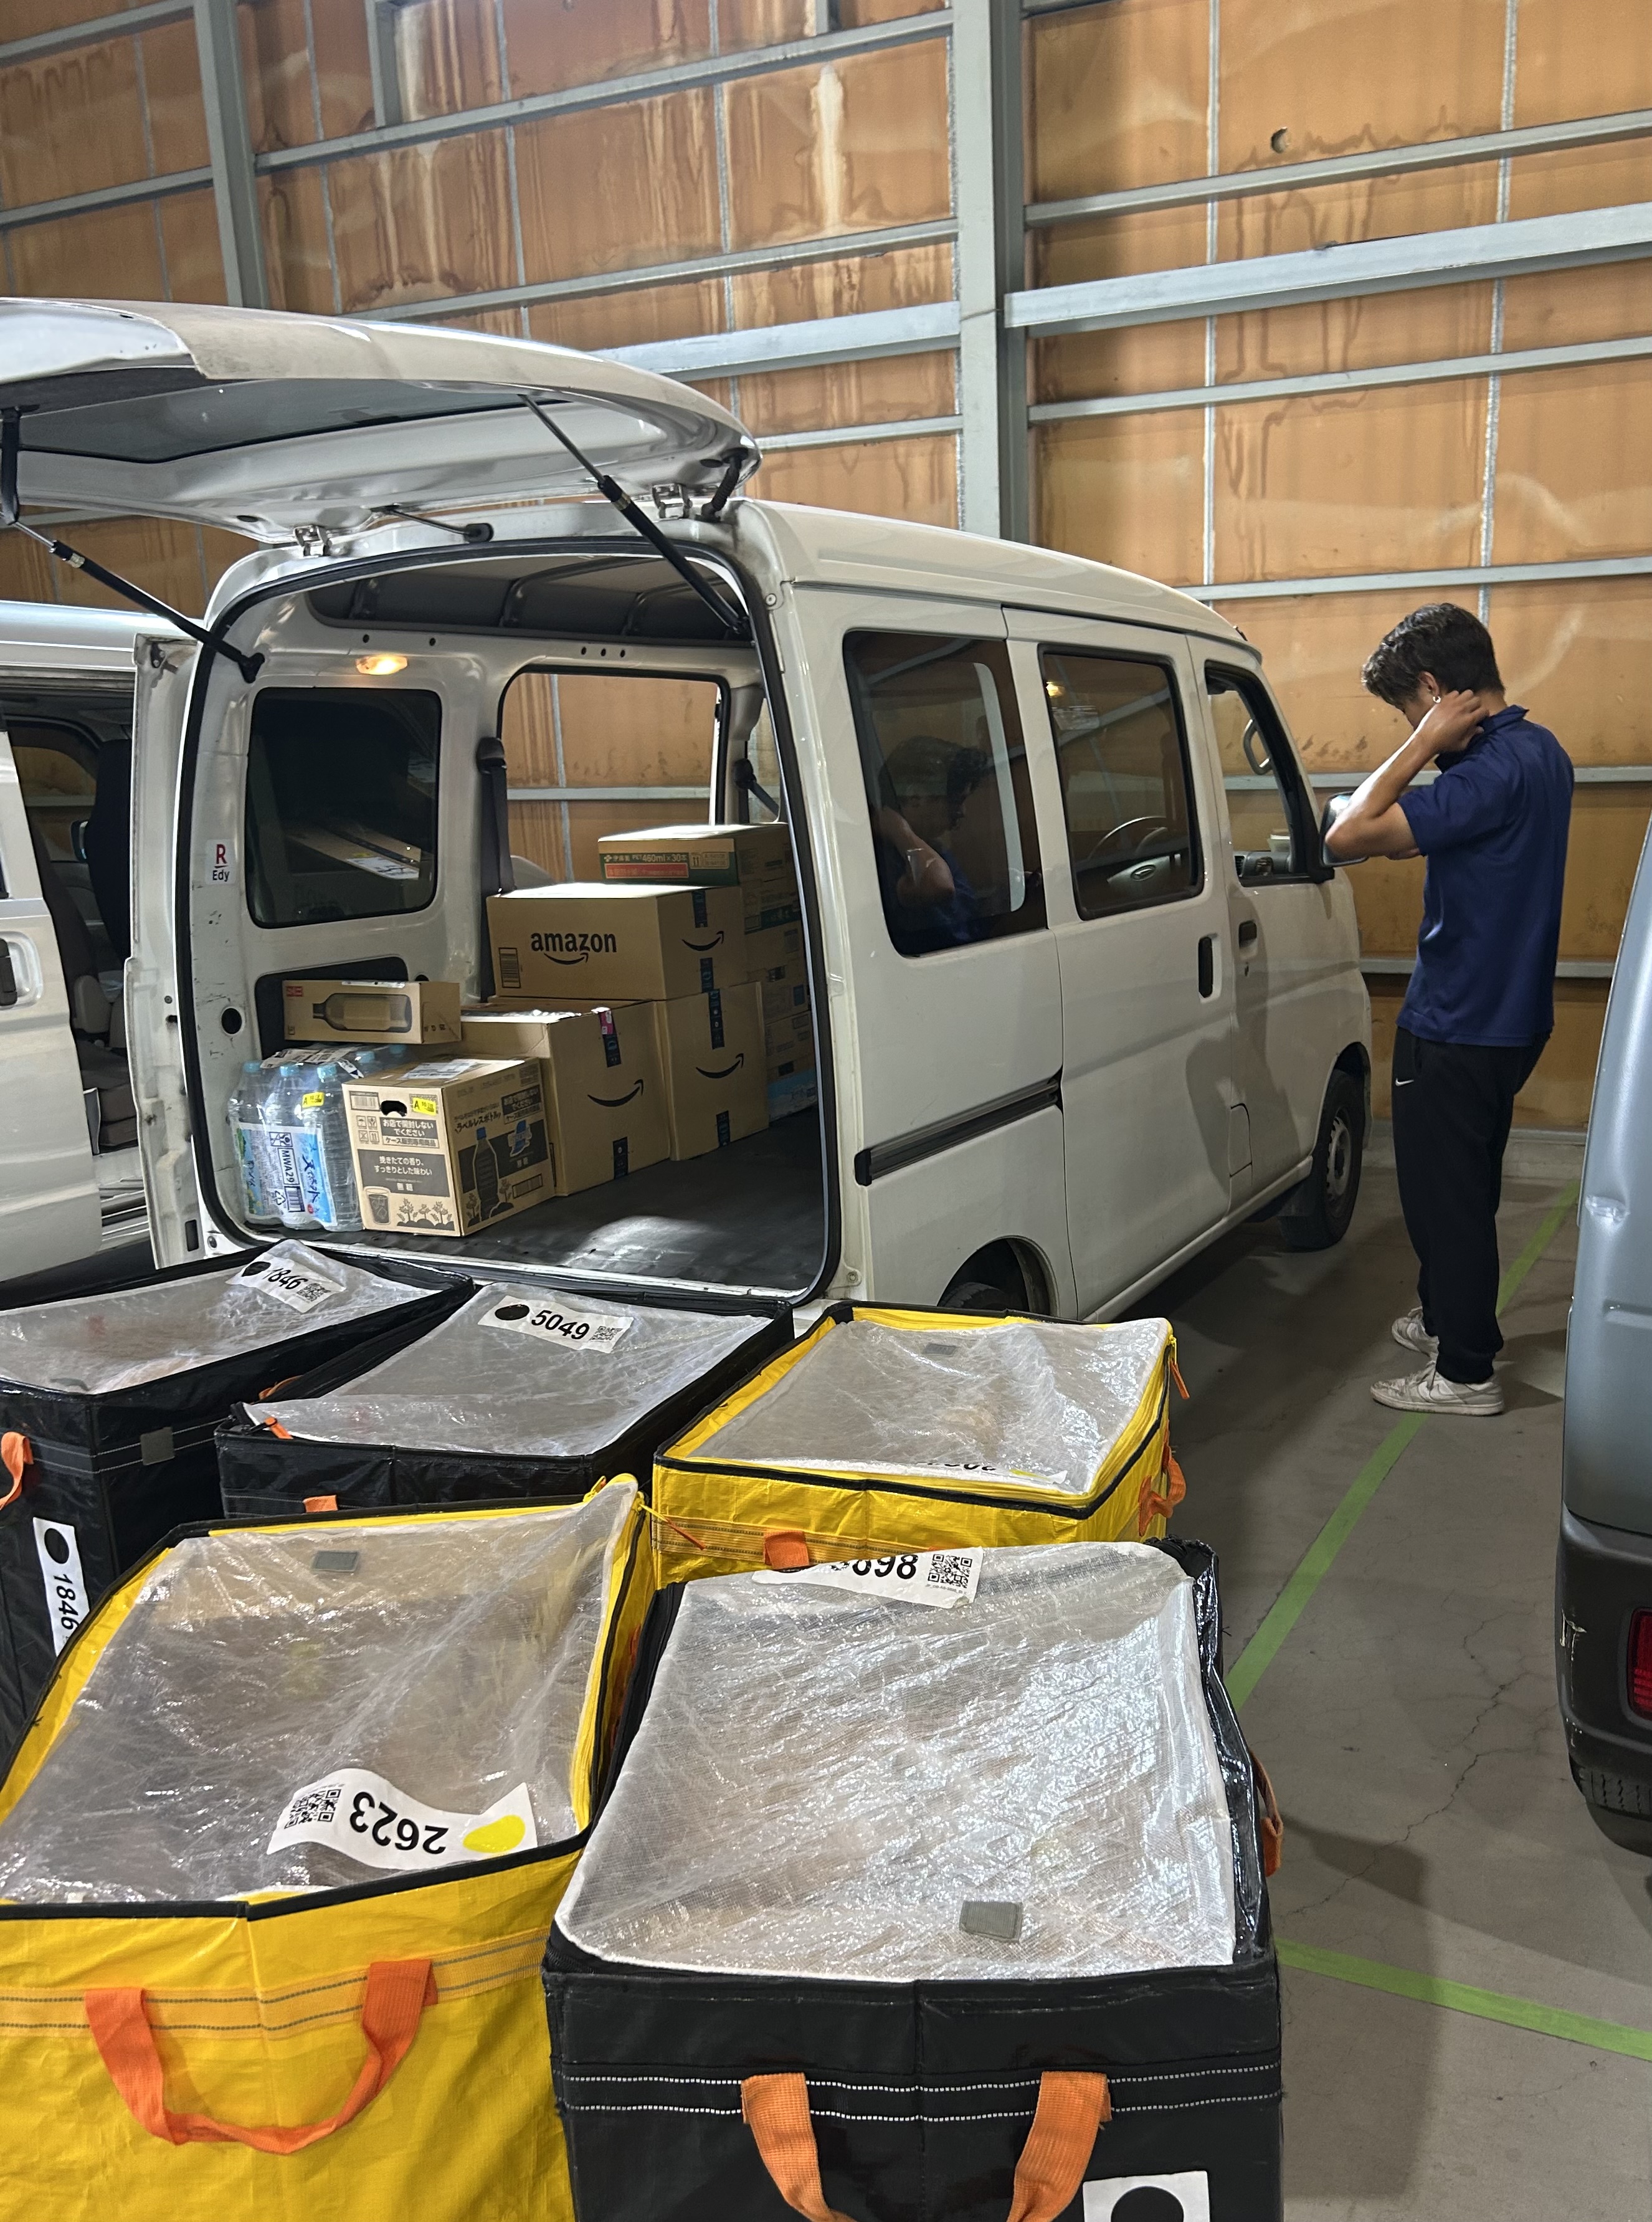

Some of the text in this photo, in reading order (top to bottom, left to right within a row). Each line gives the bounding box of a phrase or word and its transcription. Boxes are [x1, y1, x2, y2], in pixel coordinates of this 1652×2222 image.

[216, 844, 227, 864] R
[212, 869, 230, 882] Edy
[531, 932, 617, 953] amazon
[394, 1128, 425, 1137] でください
[282, 1150, 295, 1183] MWA29
[262, 1268, 308, 1290] 1846
[531, 1310, 589, 1340] 5049
[54, 1574, 80, 1630] 1846
[349, 1791, 449, 1854] 2623
